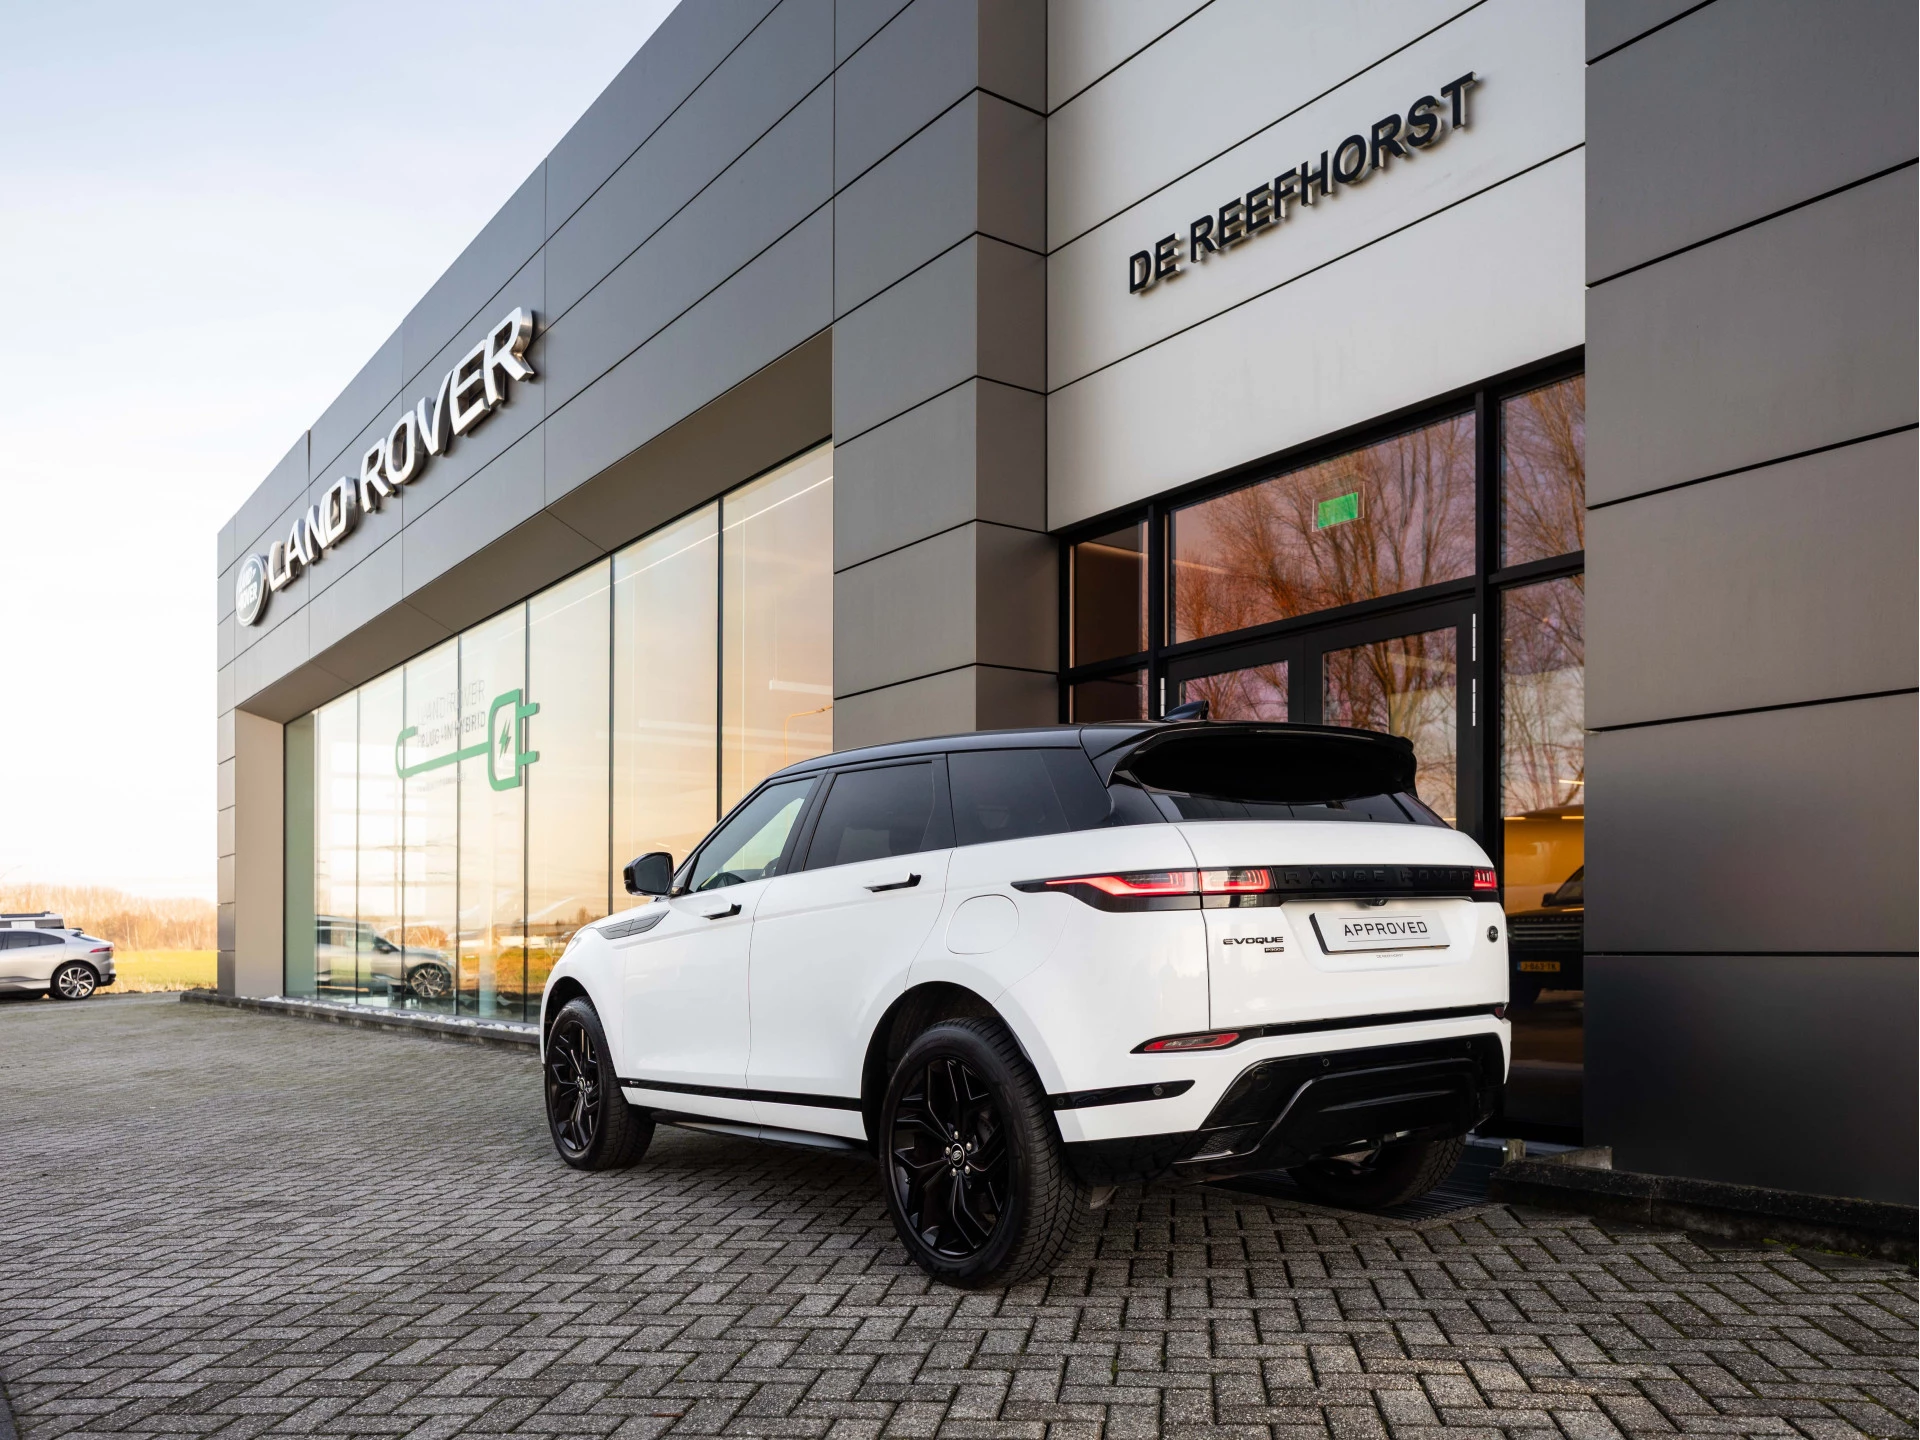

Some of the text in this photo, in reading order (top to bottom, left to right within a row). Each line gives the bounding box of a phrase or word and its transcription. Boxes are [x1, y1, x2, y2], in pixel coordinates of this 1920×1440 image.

[1129, 71, 1477, 295] DE REEFHORST
[267, 306, 534, 593] LAND ROVER
[1283, 869, 1386, 885] RANGE
[1344, 921, 1428, 937] APPROVED
[1222, 936, 1284, 945] EVOQUE
